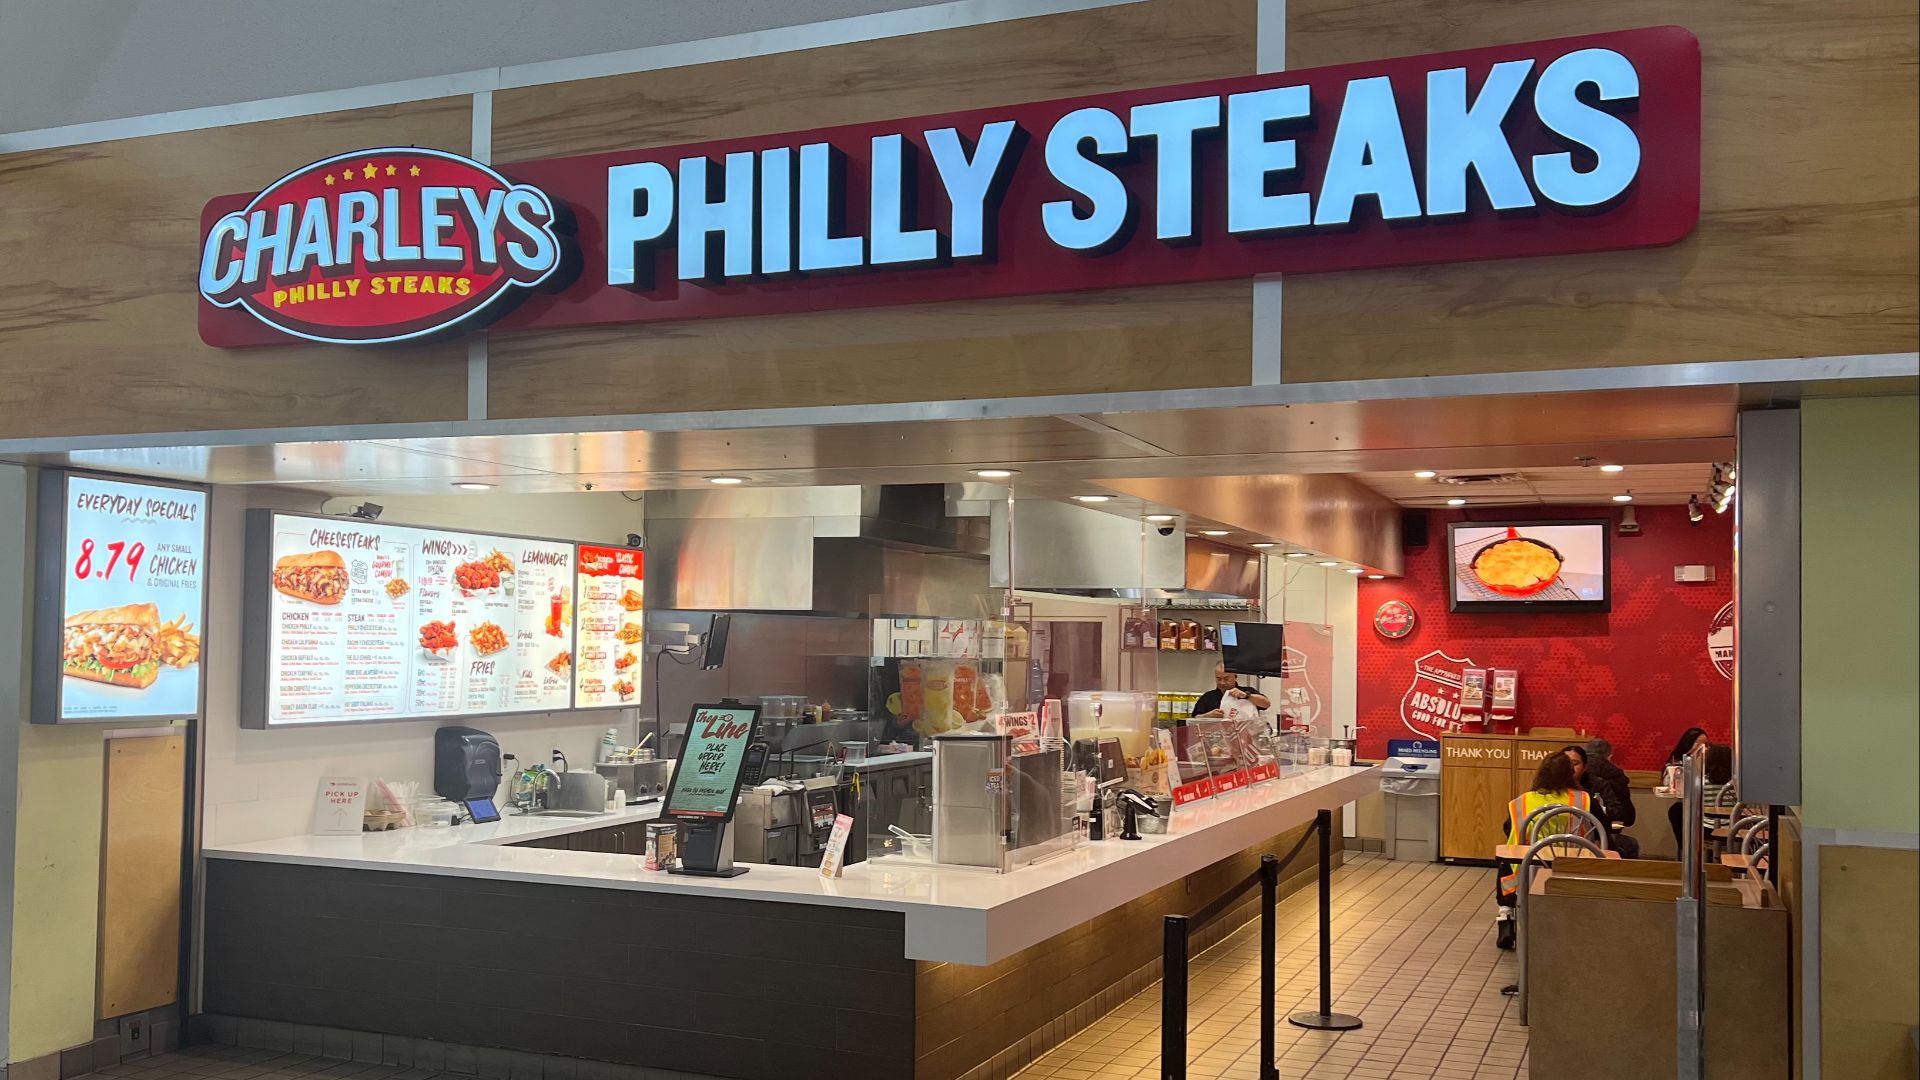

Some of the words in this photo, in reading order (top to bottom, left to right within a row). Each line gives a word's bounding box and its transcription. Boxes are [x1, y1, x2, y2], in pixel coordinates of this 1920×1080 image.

[607, 120, 1016, 286] PHILLY
[1042, 47, 1642, 251] STEAKS
[201, 186, 556, 295] CHARLEYS
[273, 279, 362, 308] PHILLY
[370, 275, 472, 296] STEAKS
[77, 493, 142, 517] EVERYDAY
[145, 498, 197, 521] SPECIALS
[310, 528, 381, 551] CHEESESTEAKS
[422, 539, 452, 556] WINGS
[157, 543, 170, 552] ANY
[171, 544, 192, 554] SMALL
[75, 538, 145, 583] 8.79
[149, 554, 197, 577] CHICKEN
[521, 549, 568, 567] LEMONADES
[153, 578, 180, 588] ORIGINAL
[181, 580, 197, 589] FRIES
[281, 611, 310, 621] CHICKEN
[347, 613, 365, 622] STEAK
[470, 660, 496, 676] FRIES
[1423, 664, 1435, 672] THE
[1411, 691, 1461, 720] ABSOLU
[696, 710, 714, 723] the
[1004, 716, 1028, 727] WINGS
[1411, 709, 1431, 723] GOOD
[1432, 716, 1447, 728] FOR
[701, 715, 749, 740] Line
[705, 743, 728, 752] PLACE
[1445, 746, 1483, 759] THANK
[1484, 748, 1511, 759] YOU
[1521, 749, 1553, 761] THAN
[698, 752, 724, 761] ORDER
[698, 762, 726, 773] HERE!
